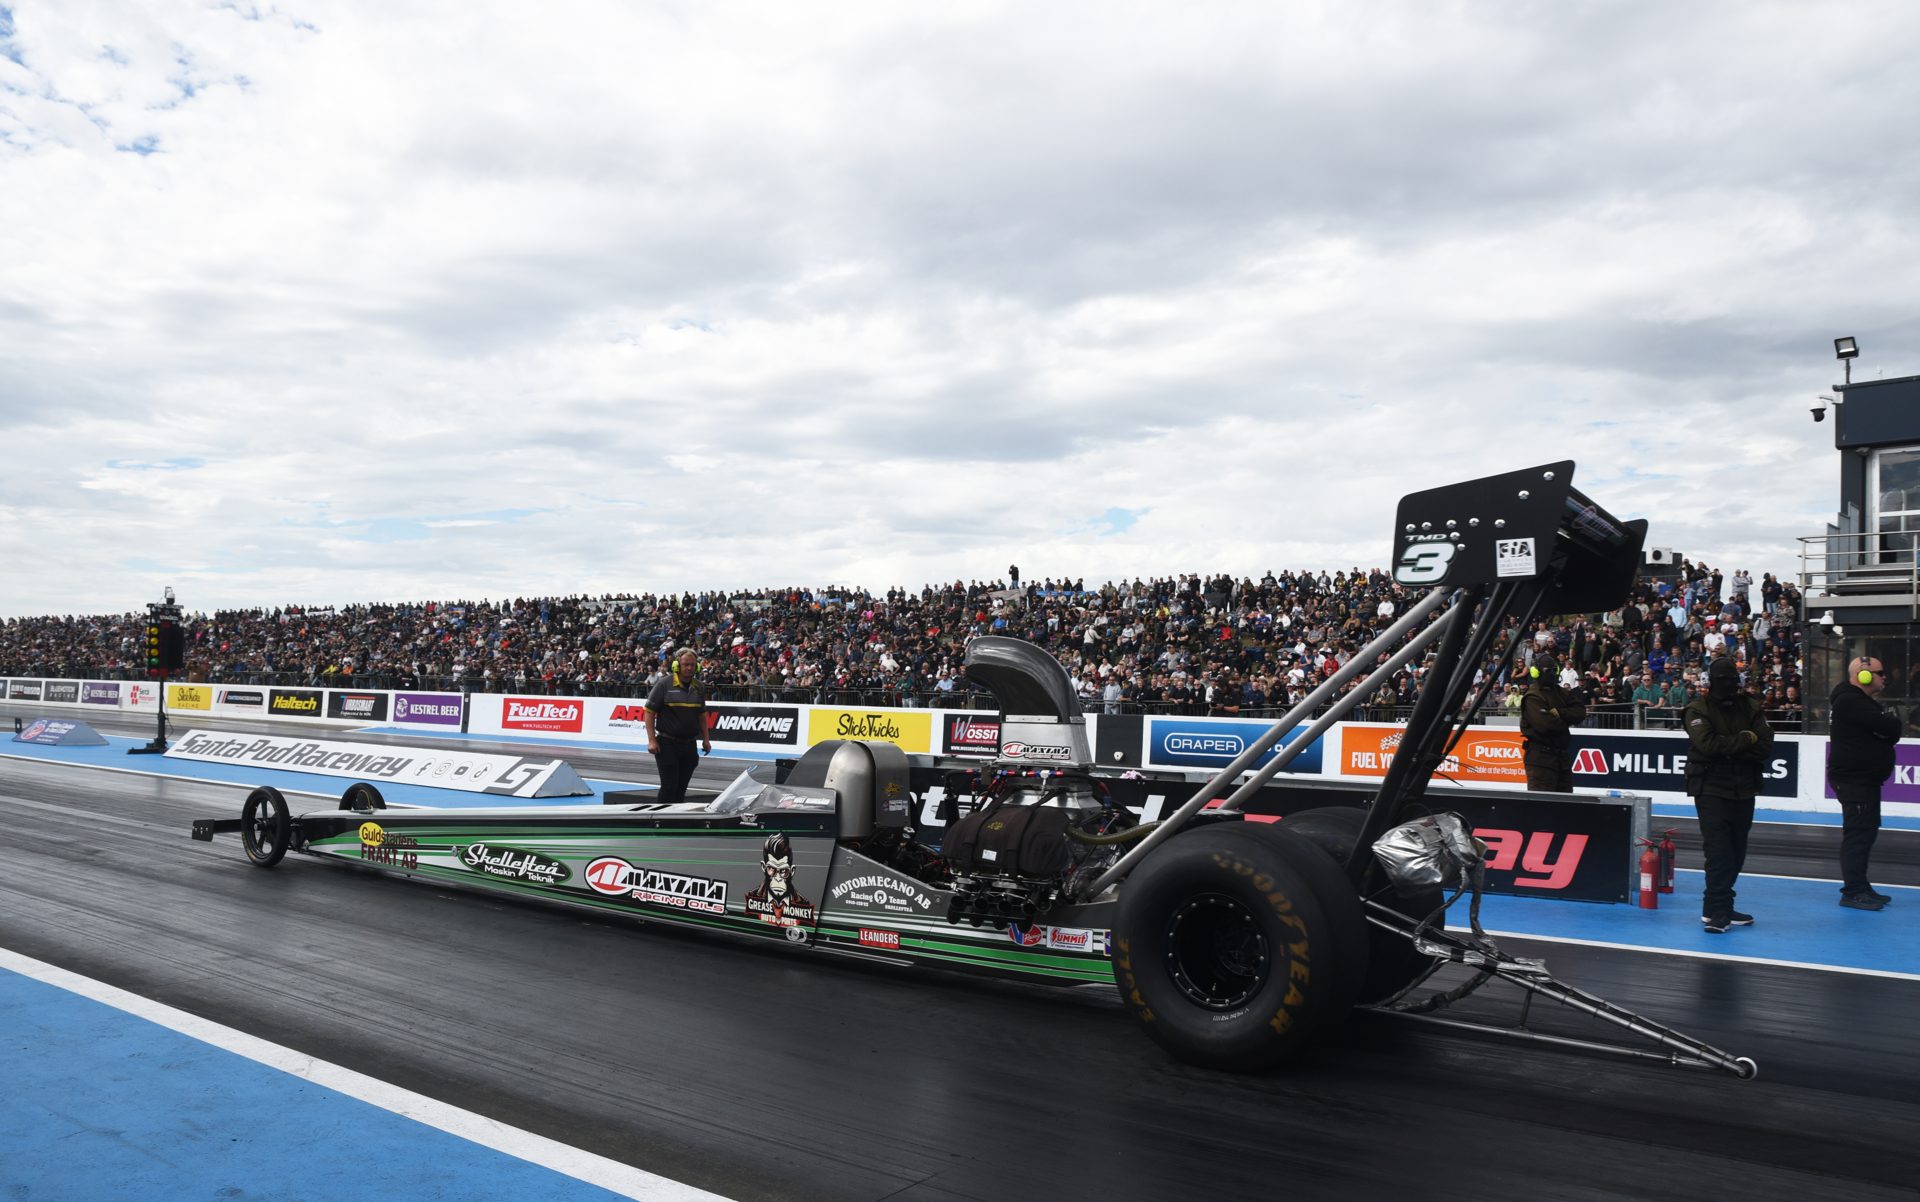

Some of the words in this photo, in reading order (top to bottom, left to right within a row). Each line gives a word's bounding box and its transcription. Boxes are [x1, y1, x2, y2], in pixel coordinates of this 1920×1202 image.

[1405, 533, 1447, 541] TMD
[1395, 542, 1455, 583] 3
[273, 695, 317, 711] Haltech
[410, 703, 439, 715] KESTREL
[441, 705, 460, 717] BEER
[508, 702, 579, 720] FuelTech
[609, 705, 645, 721] AR
[716, 715, 794, 732] NANKANG
[1171, 738, 1237, 751] DRAPER
[1475, 745, 1522, 759] PUKKA
[1352, 752, 1378, 769] FUEL
[361, 843, 398, 866] FRAKT
[401, 851, 418, 870] AB
[484, 865, 516, 877] Maskin
[527, 872, 555, 884] Teknik
[620, 869, 727, 902] MAXIMA
[832, 875, 915, 899] MOTORMECANO
[914, 893, 931, 909] AB
[632, 890, 685, 906] RACING
[688, 900, 724, 913] OILS
[850, 891, 874, 903] Racing
[888, 895, 907, 906] Team
[748, 899, 774, 913] GREASE
[783, 905, 812, 920] MONKEY
[859, 929, 899, 945] LEANDERS
